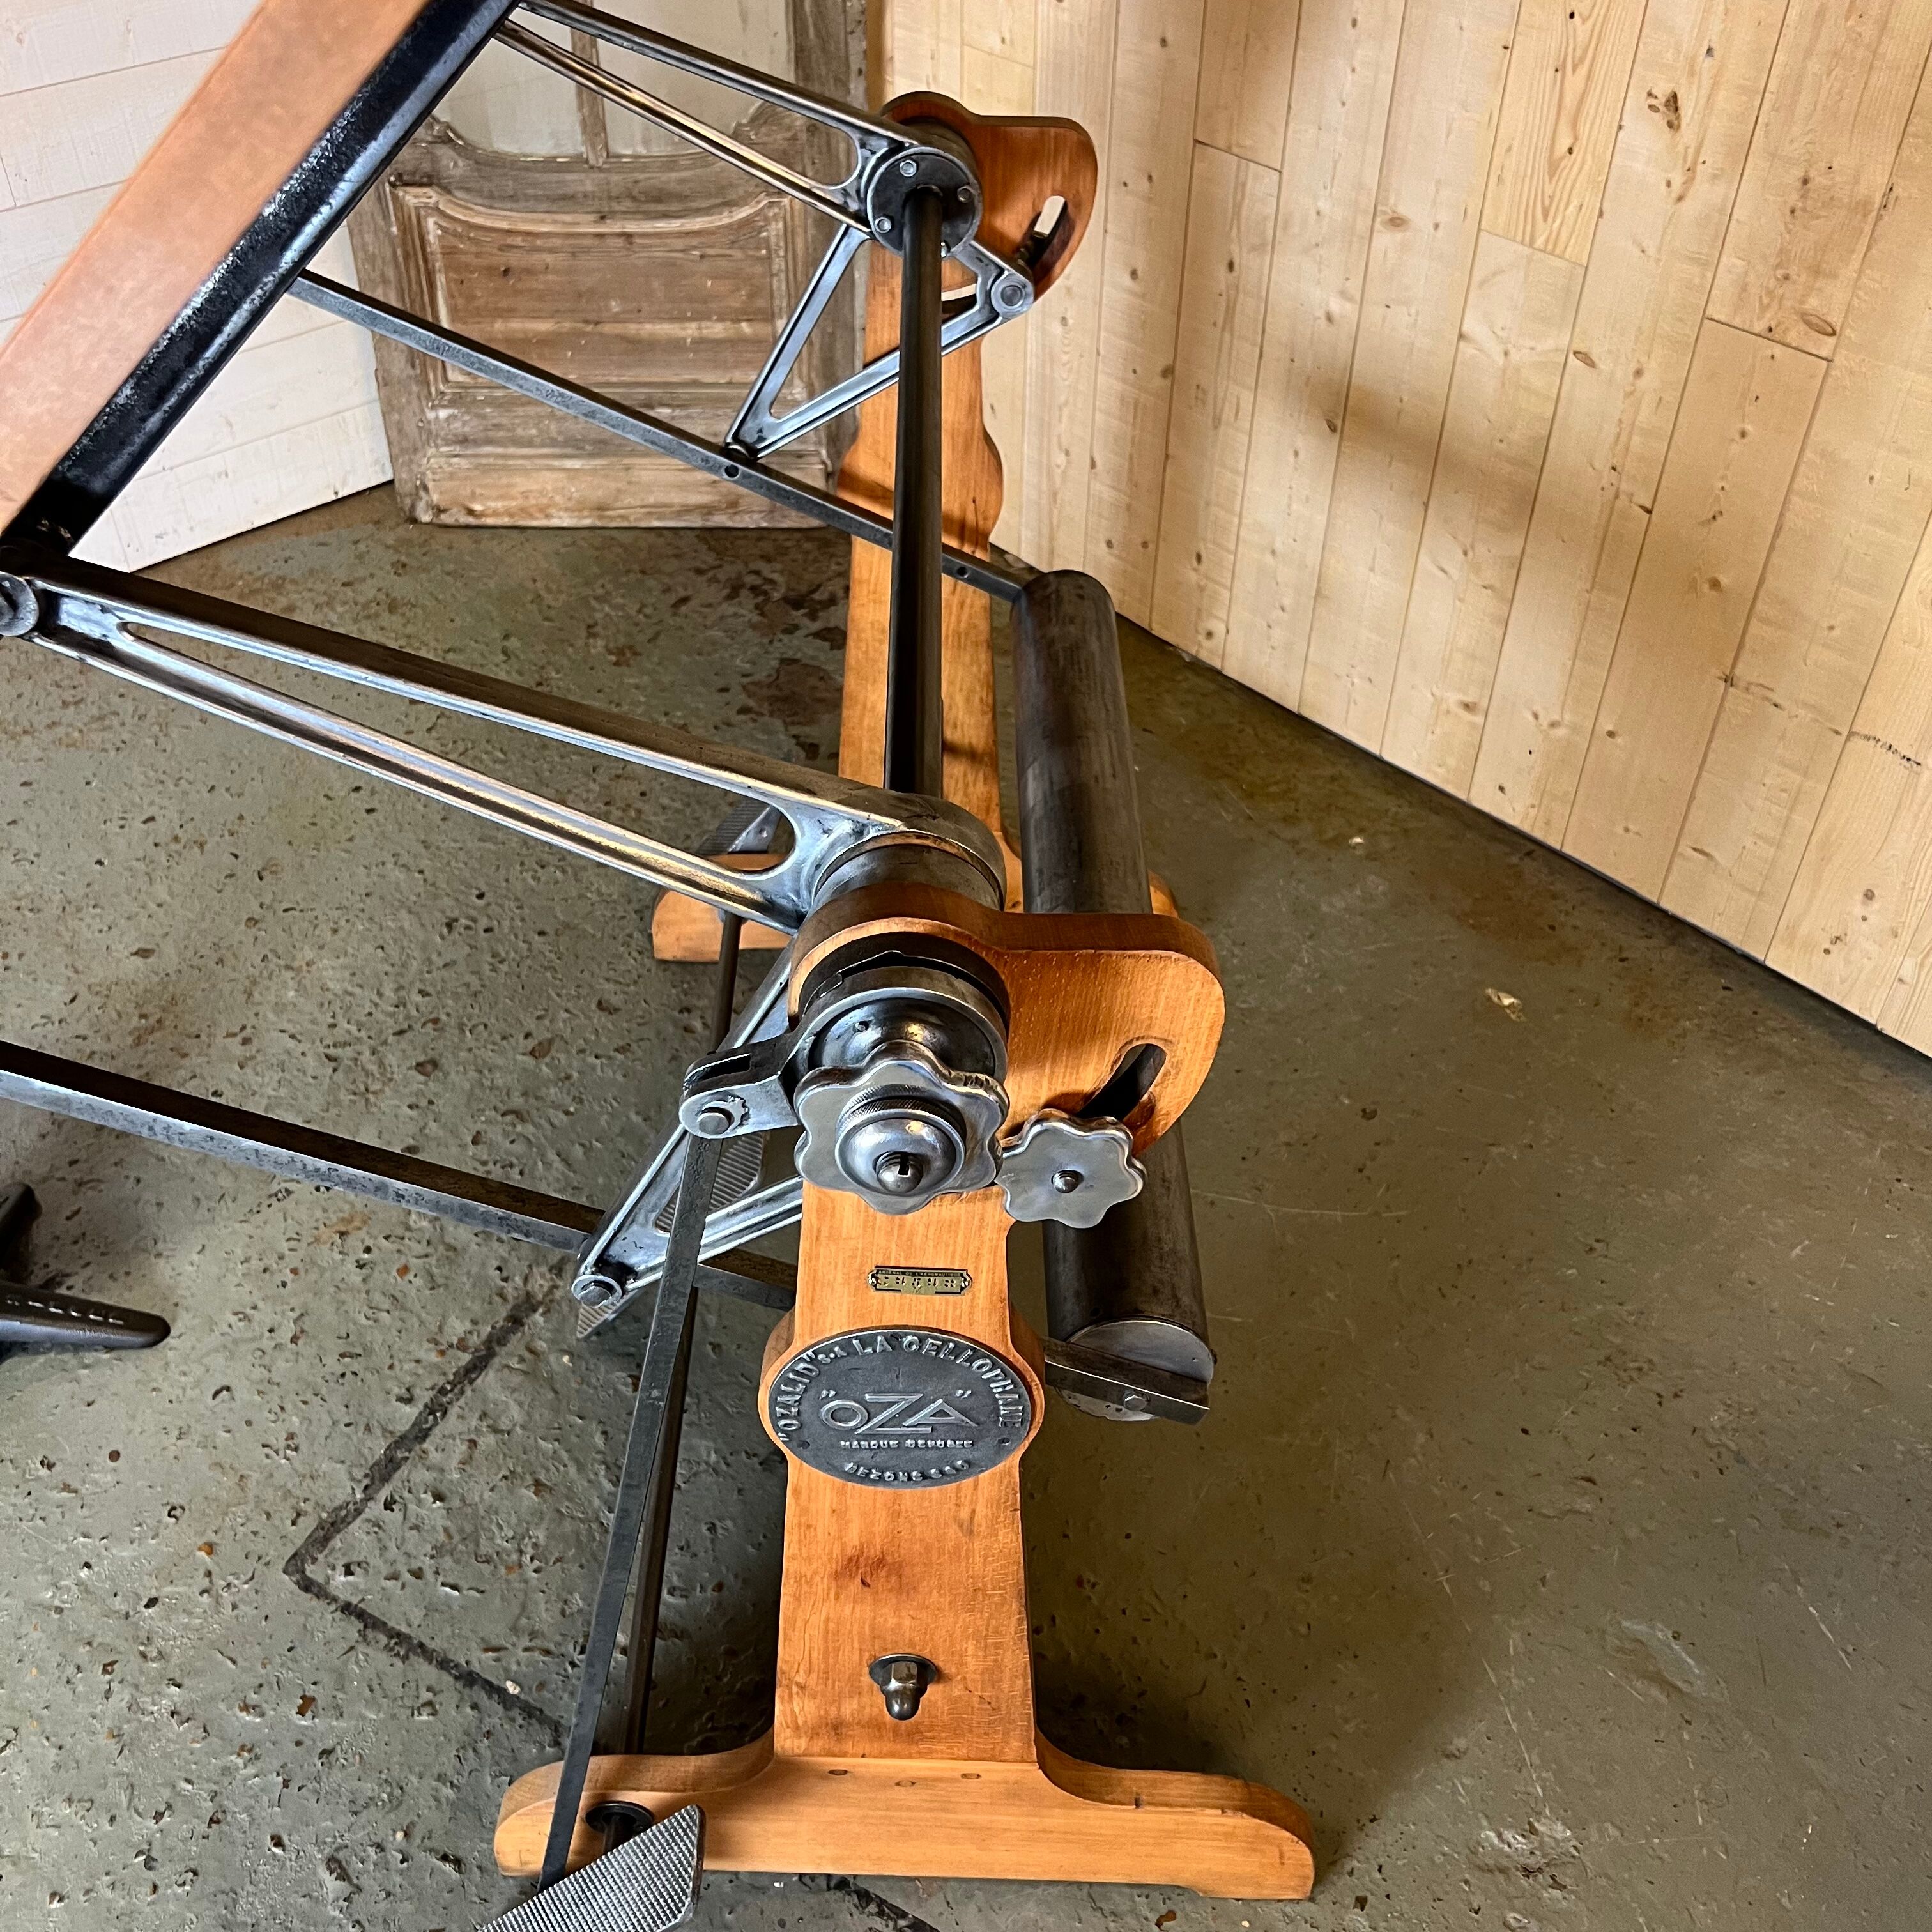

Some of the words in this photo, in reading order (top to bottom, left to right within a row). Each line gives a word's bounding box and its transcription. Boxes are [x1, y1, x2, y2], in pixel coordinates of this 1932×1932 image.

[852, 1335, 893, 1355] LA
[903, 1335, 1023, 1427] CELLOPHANE
[840, 1439, 899, 1449] MARQUE
